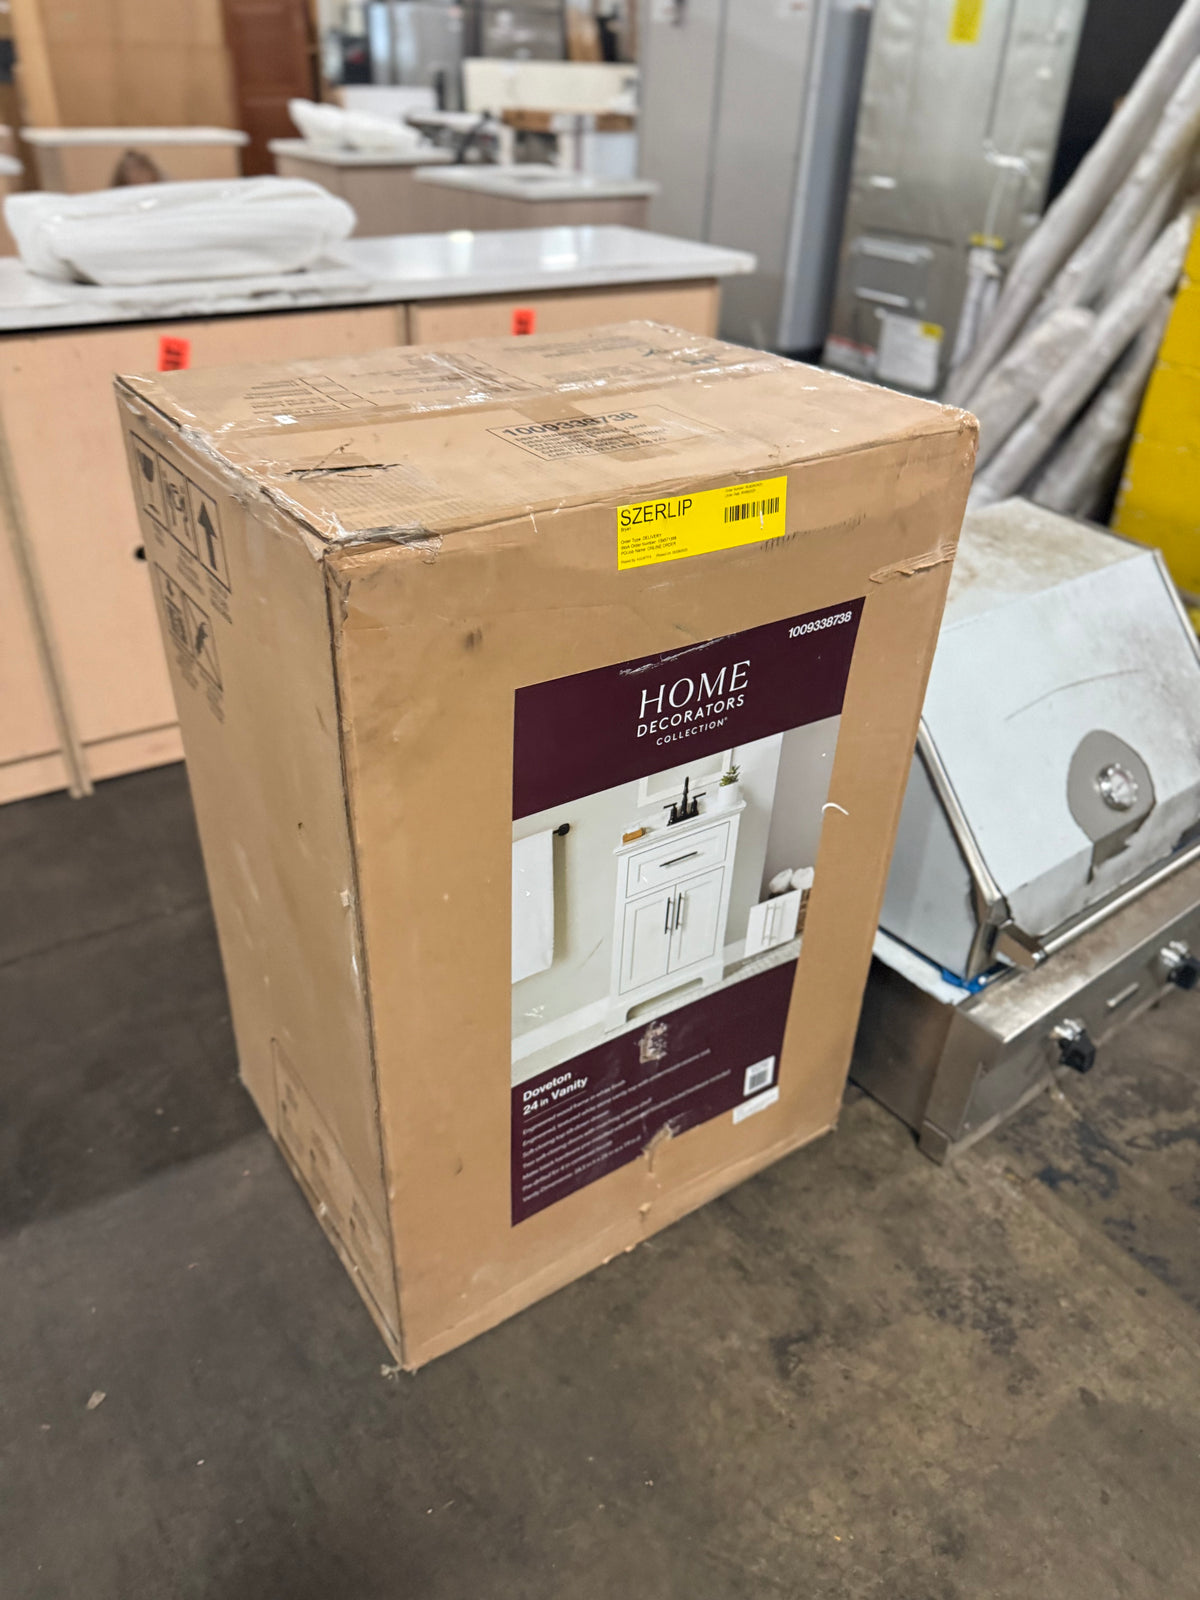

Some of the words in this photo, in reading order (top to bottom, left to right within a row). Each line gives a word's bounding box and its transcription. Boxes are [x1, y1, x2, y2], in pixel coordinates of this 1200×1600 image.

[502, 411, 639, 437] 1009338738
[620, 498, 692, 526] SZERLIP
[789, 611, 853, 638] 1009338738
[639, 660, 750, 719] HOME
[637, 694, 744, 737] DECORATORS
[522, 1100, 538, 1116] 24
[539, 1097, 548, 1107] in
[551, 1075, 587, 1103] Vanity
[523, 1071, 571, 1102] Doveton
